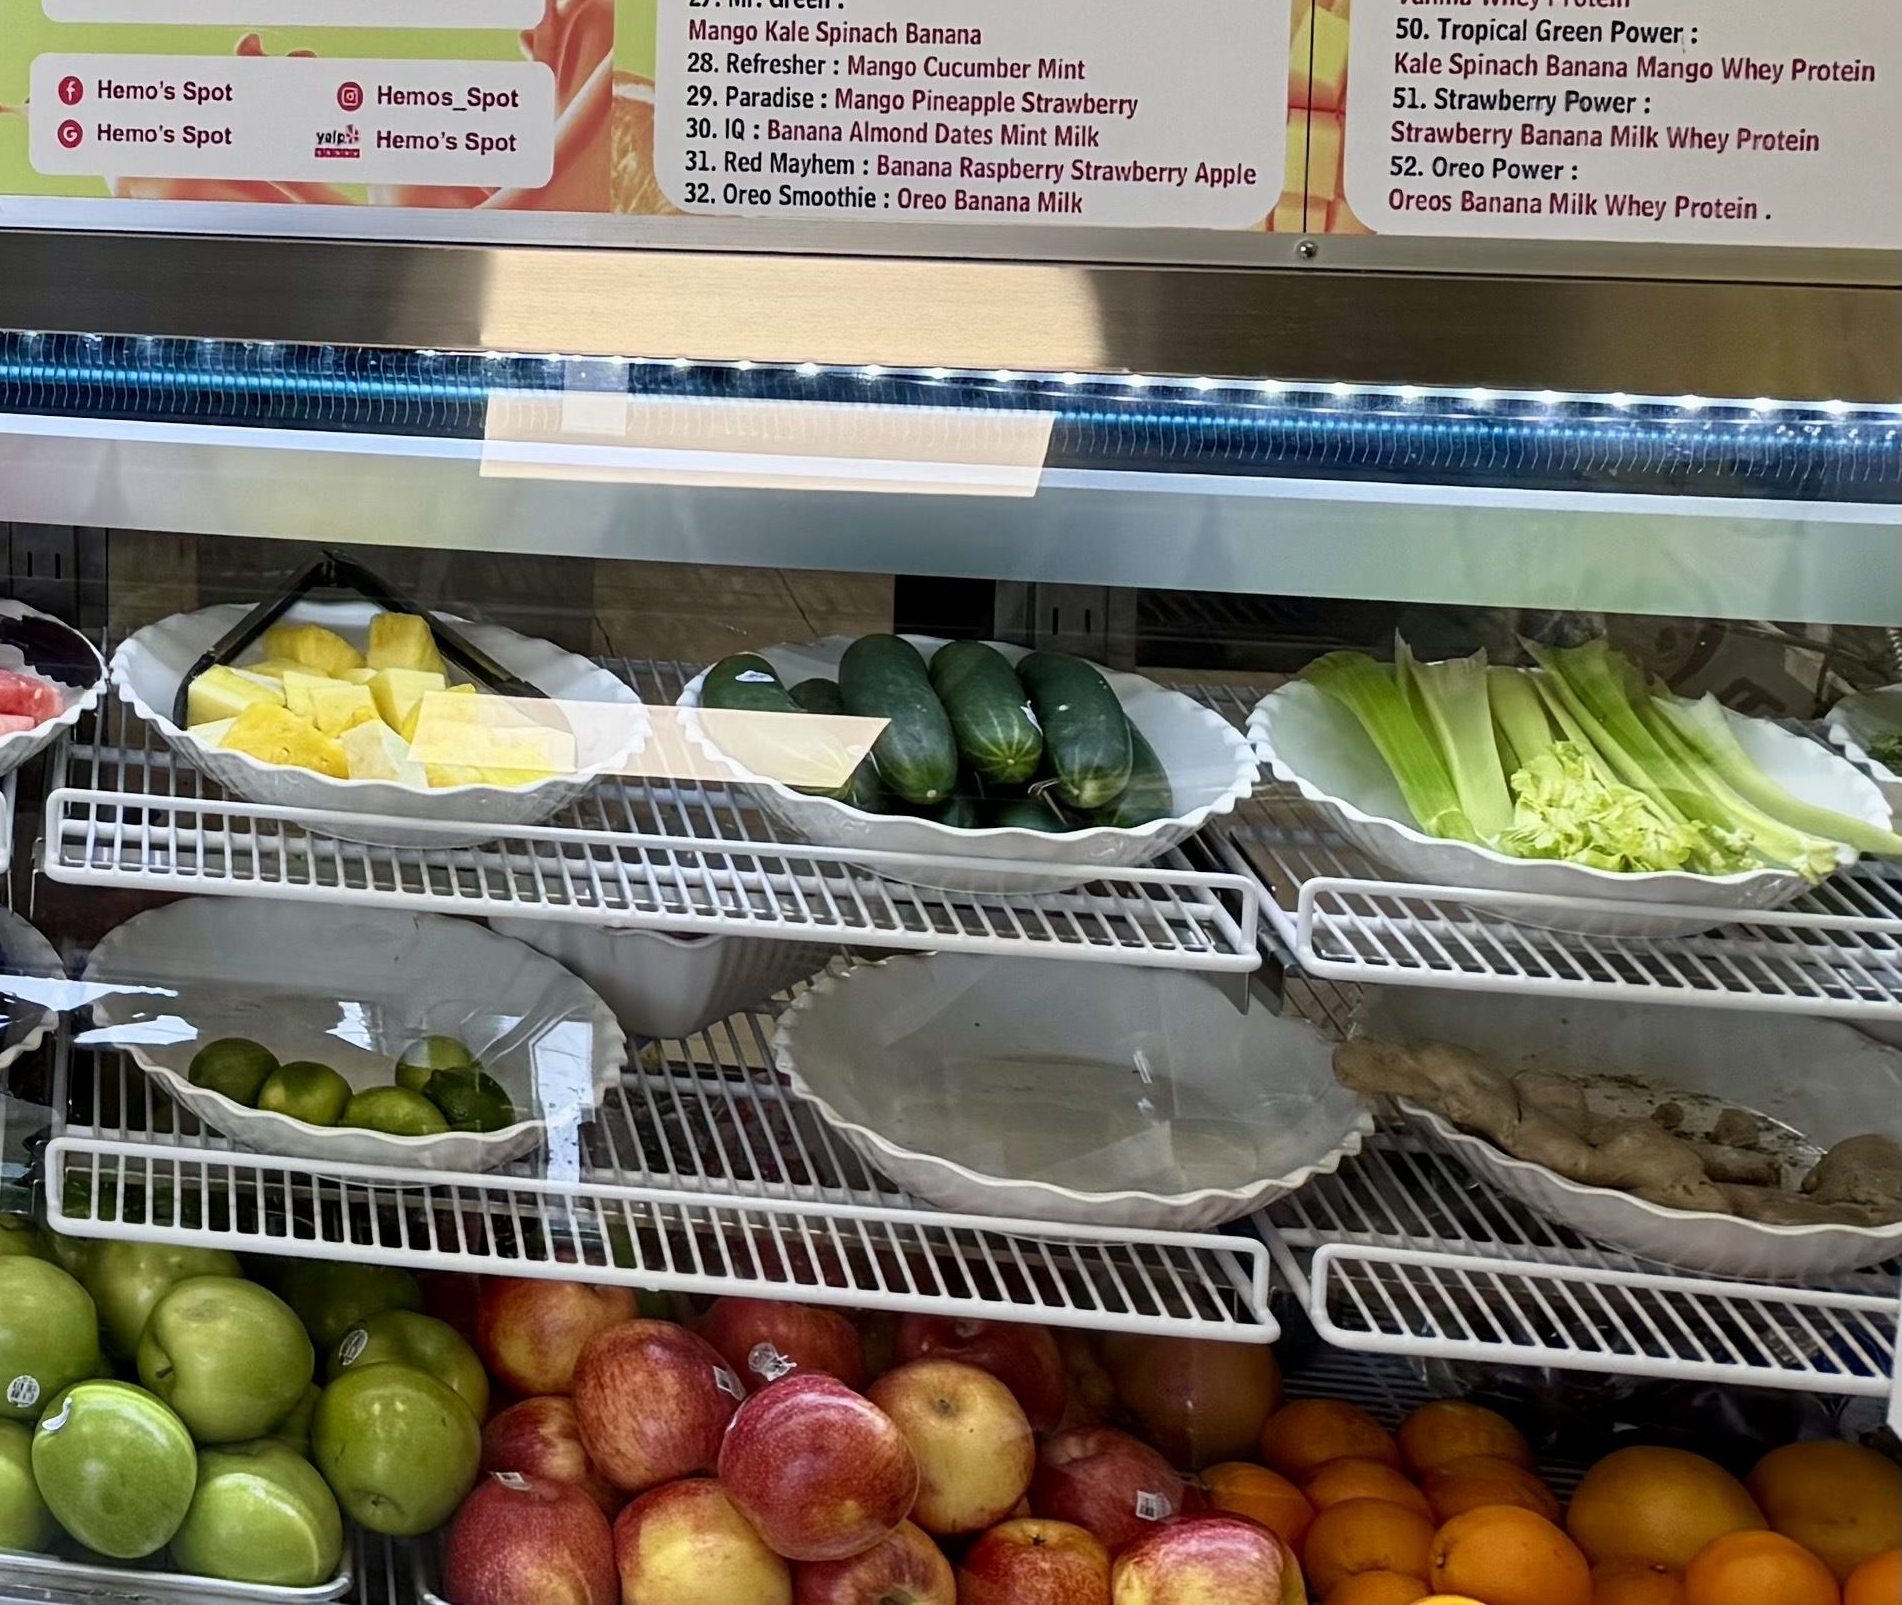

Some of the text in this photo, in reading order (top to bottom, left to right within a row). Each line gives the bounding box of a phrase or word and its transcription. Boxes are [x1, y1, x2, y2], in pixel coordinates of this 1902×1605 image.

[689, 19, 982, 47] Mango Kale Spinach Banana
[97, 80, 233, 106] Hemo's Spot
[97, 123, 232, 150] Hemo's Spot
[377, 130, 517, 156] Hemo's Spot
[1390, 121, 1820, 153] Strawberry Banana Milk Whey Protein
